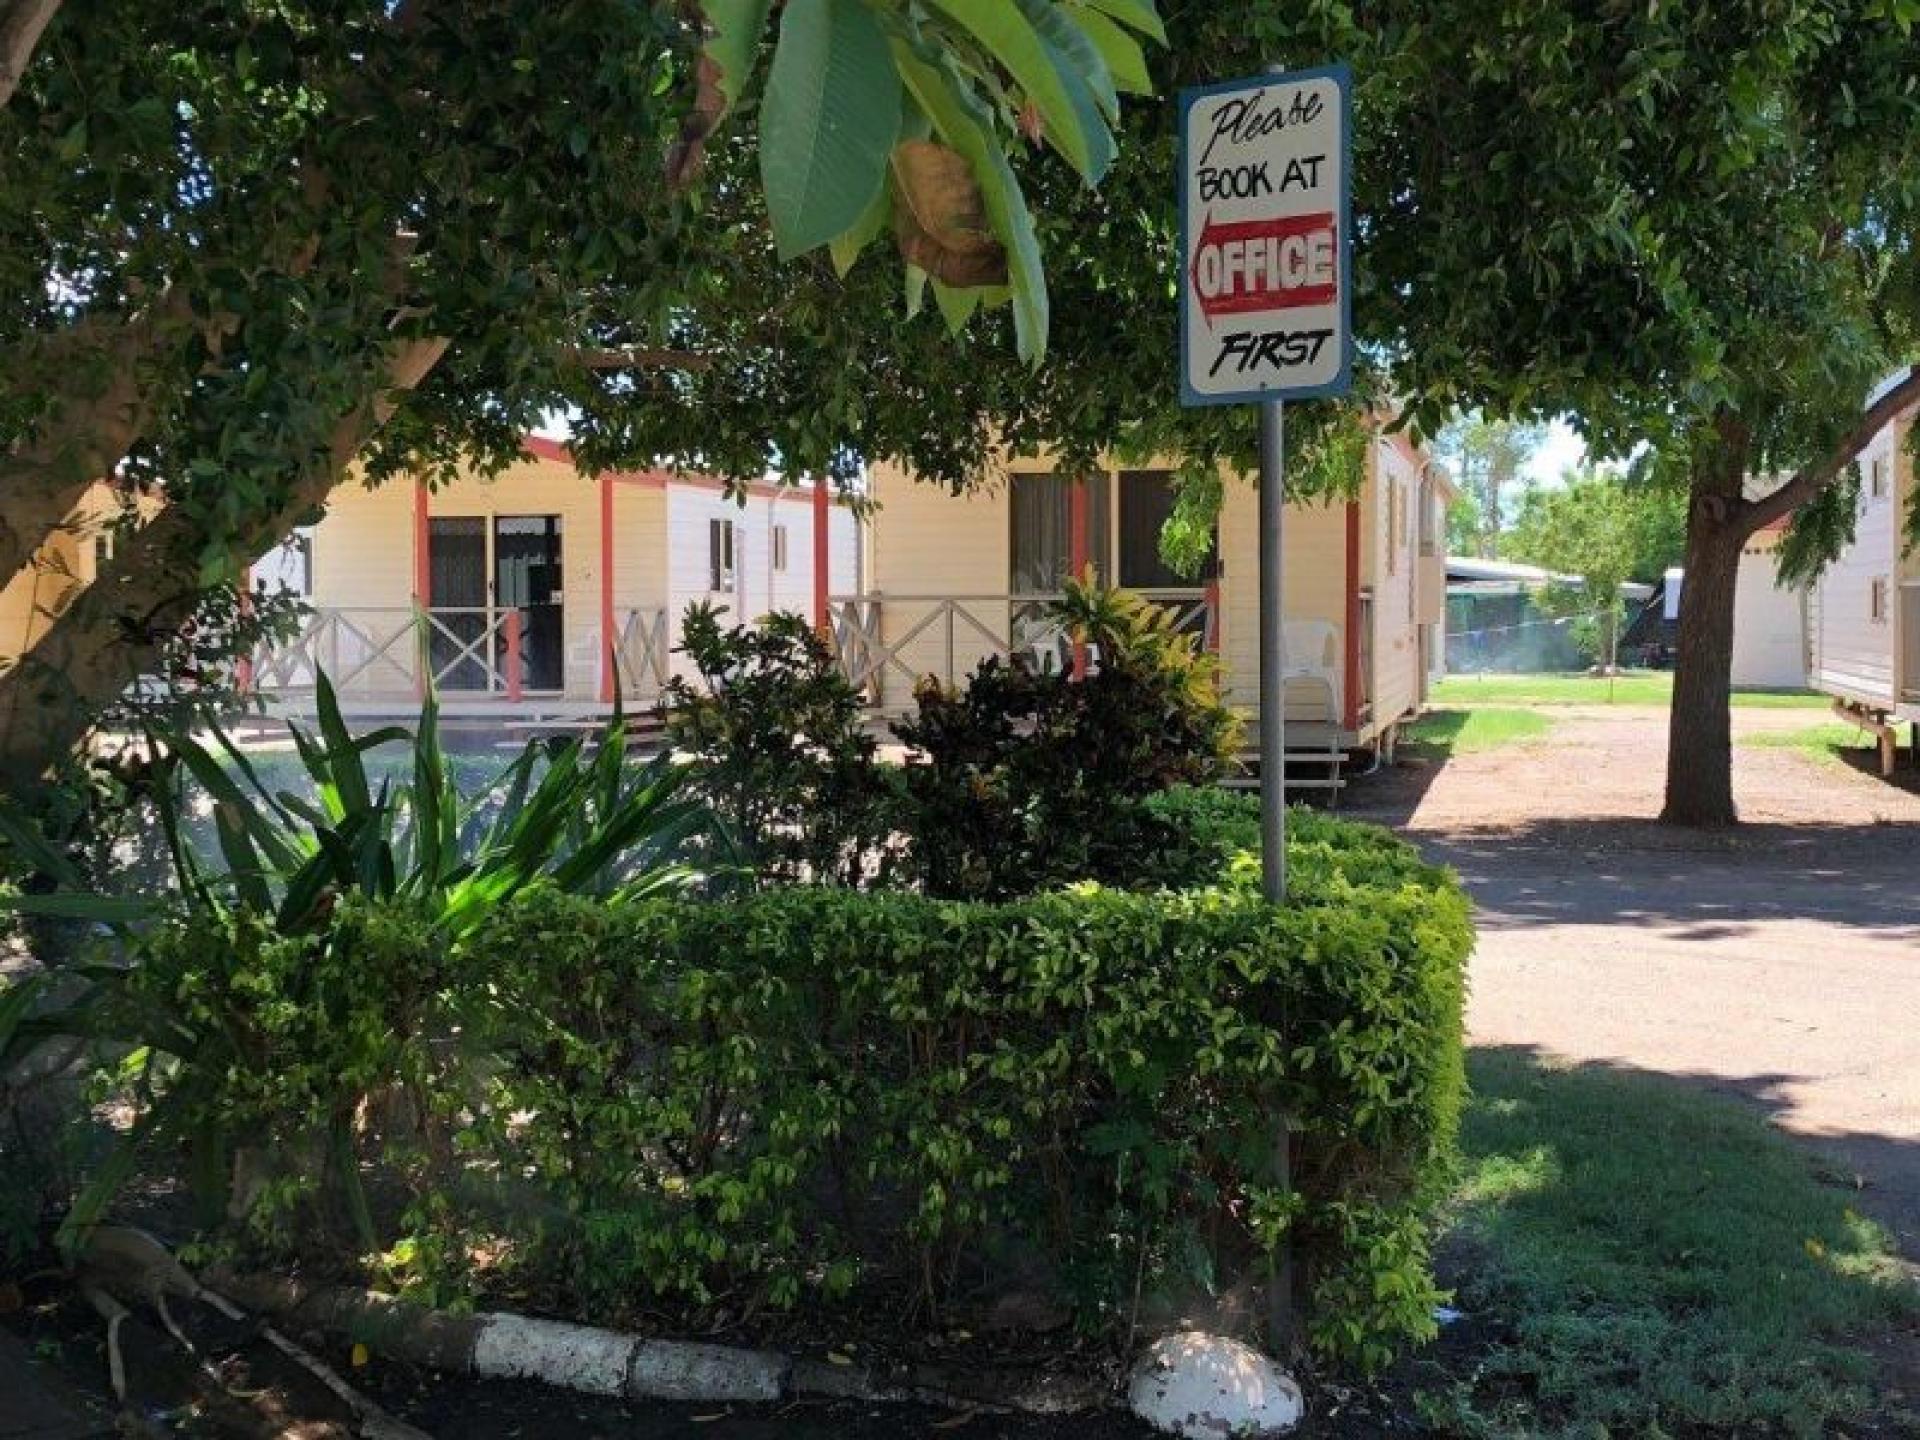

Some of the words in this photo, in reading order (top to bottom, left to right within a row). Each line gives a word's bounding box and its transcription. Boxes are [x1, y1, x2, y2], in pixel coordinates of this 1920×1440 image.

[1200, 88, 1324, 166] Please
[1196, 161, 1272, 201] BOOK
[1279, 154, 1326, 192] AT
[1197, 228, 1333, 299] OFFICE
[1209, 328, 1334, 377] FIRST
